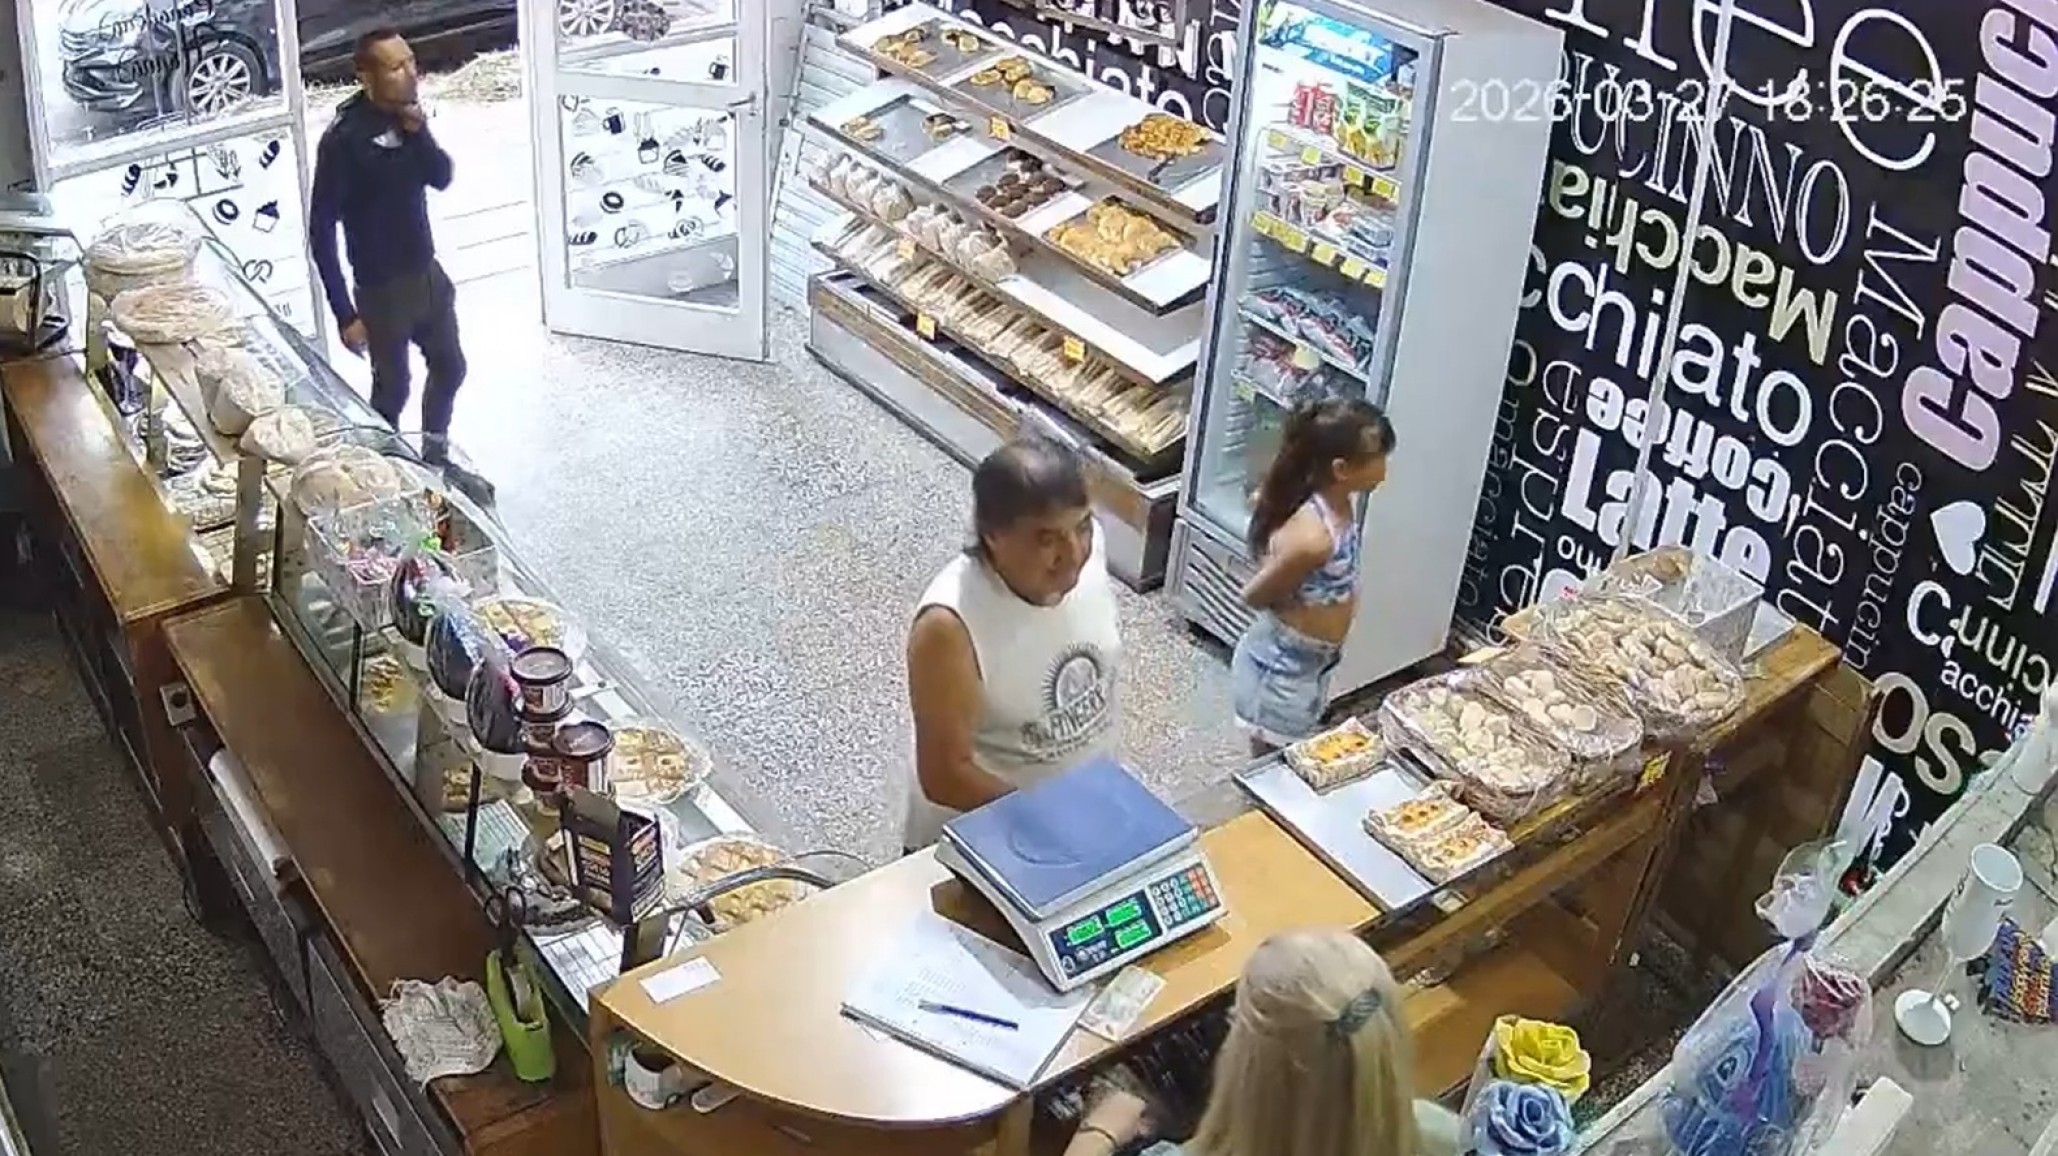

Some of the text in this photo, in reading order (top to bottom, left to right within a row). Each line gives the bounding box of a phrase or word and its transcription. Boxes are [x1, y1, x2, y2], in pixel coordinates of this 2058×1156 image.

[1560, 48, 1850, 264] UCINNO
[1901, 0, 2058, 471] Cappuc
[1550, 158, 1839, 366] Macchia
[1561, 427, 1771, 585] Latte
[1585, 376, 1790, 523] coffee
